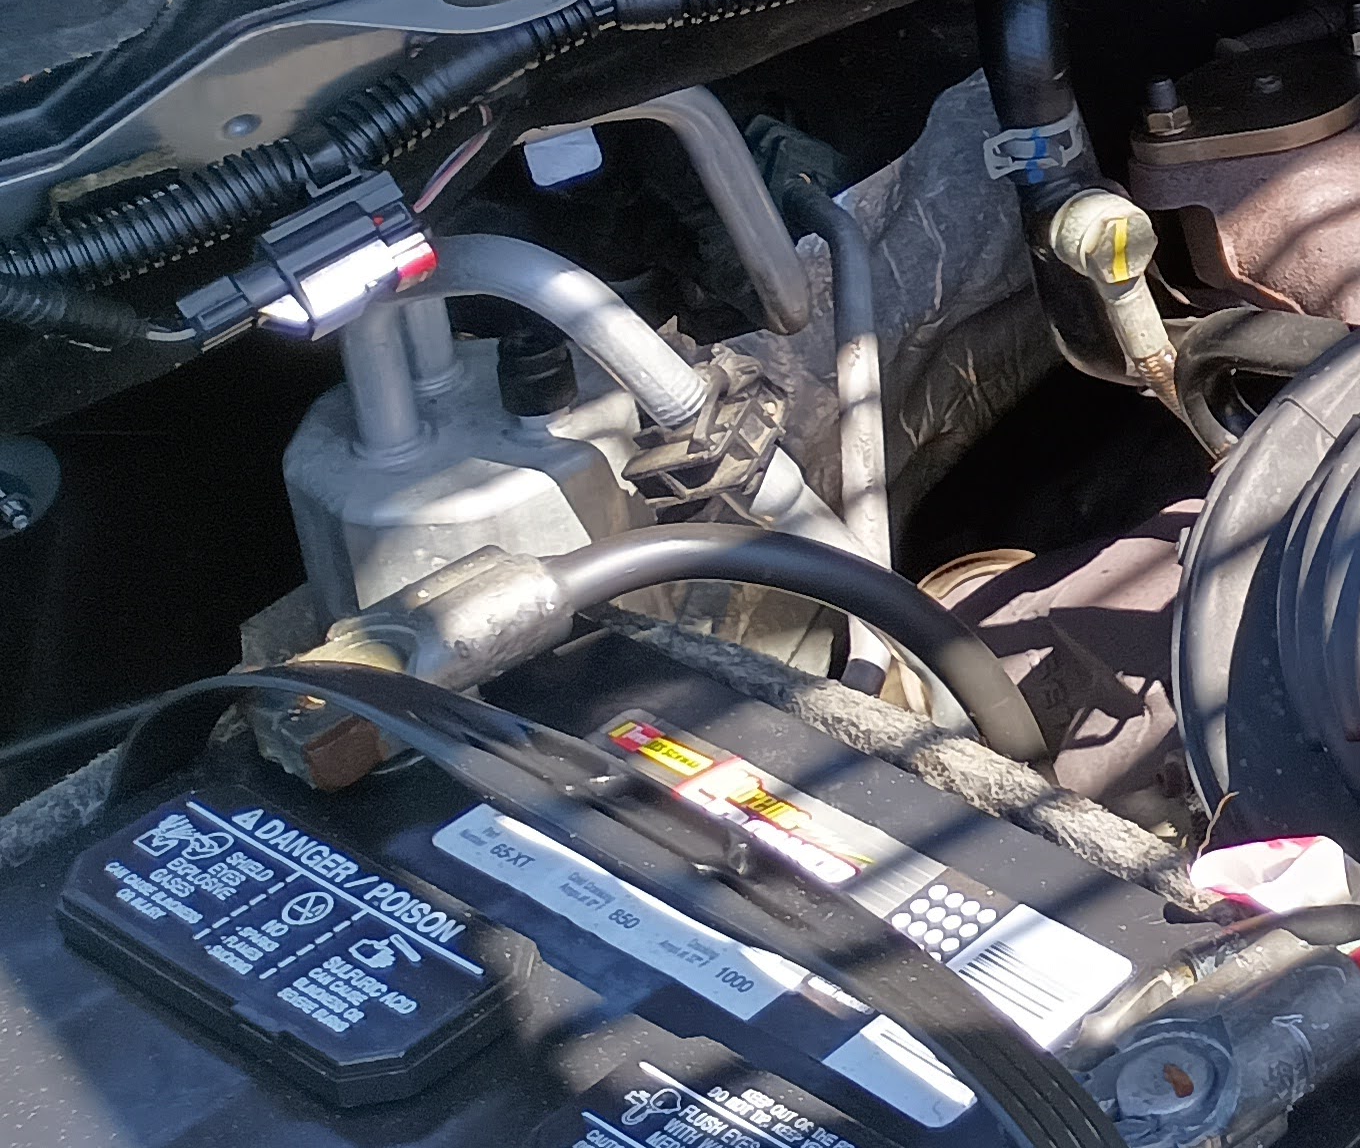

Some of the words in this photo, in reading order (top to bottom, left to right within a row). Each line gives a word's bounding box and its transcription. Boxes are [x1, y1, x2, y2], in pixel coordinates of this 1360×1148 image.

[166, 858, 236, 900] EXPLOSIVE
[208, 863, 246, 886] EYES
[226, 852, 275, 881] SHIELD
[149, 869, 195, 897] GASES
[254, 819, 359, 883] DANGER
[364, 883, 467, 944] POISON
[261, 920, 288, 936] NO
[608, 908, 640, 929] 850
[323, 956, 387, 997] SULFURIC
[380, 991, 417, 1014] ACID
[714, 966, 755, 993] 1000
[707, 1086, 730, 1102] DO
[724, 1096, 755, 1116] NOT
[663, 1117, 702, 1146] WITH
[678, 1105, 728, 1136] FLUSH
[770, 1104, 799, 1122] OUT
[811, 1127, 839, 1147] THE
